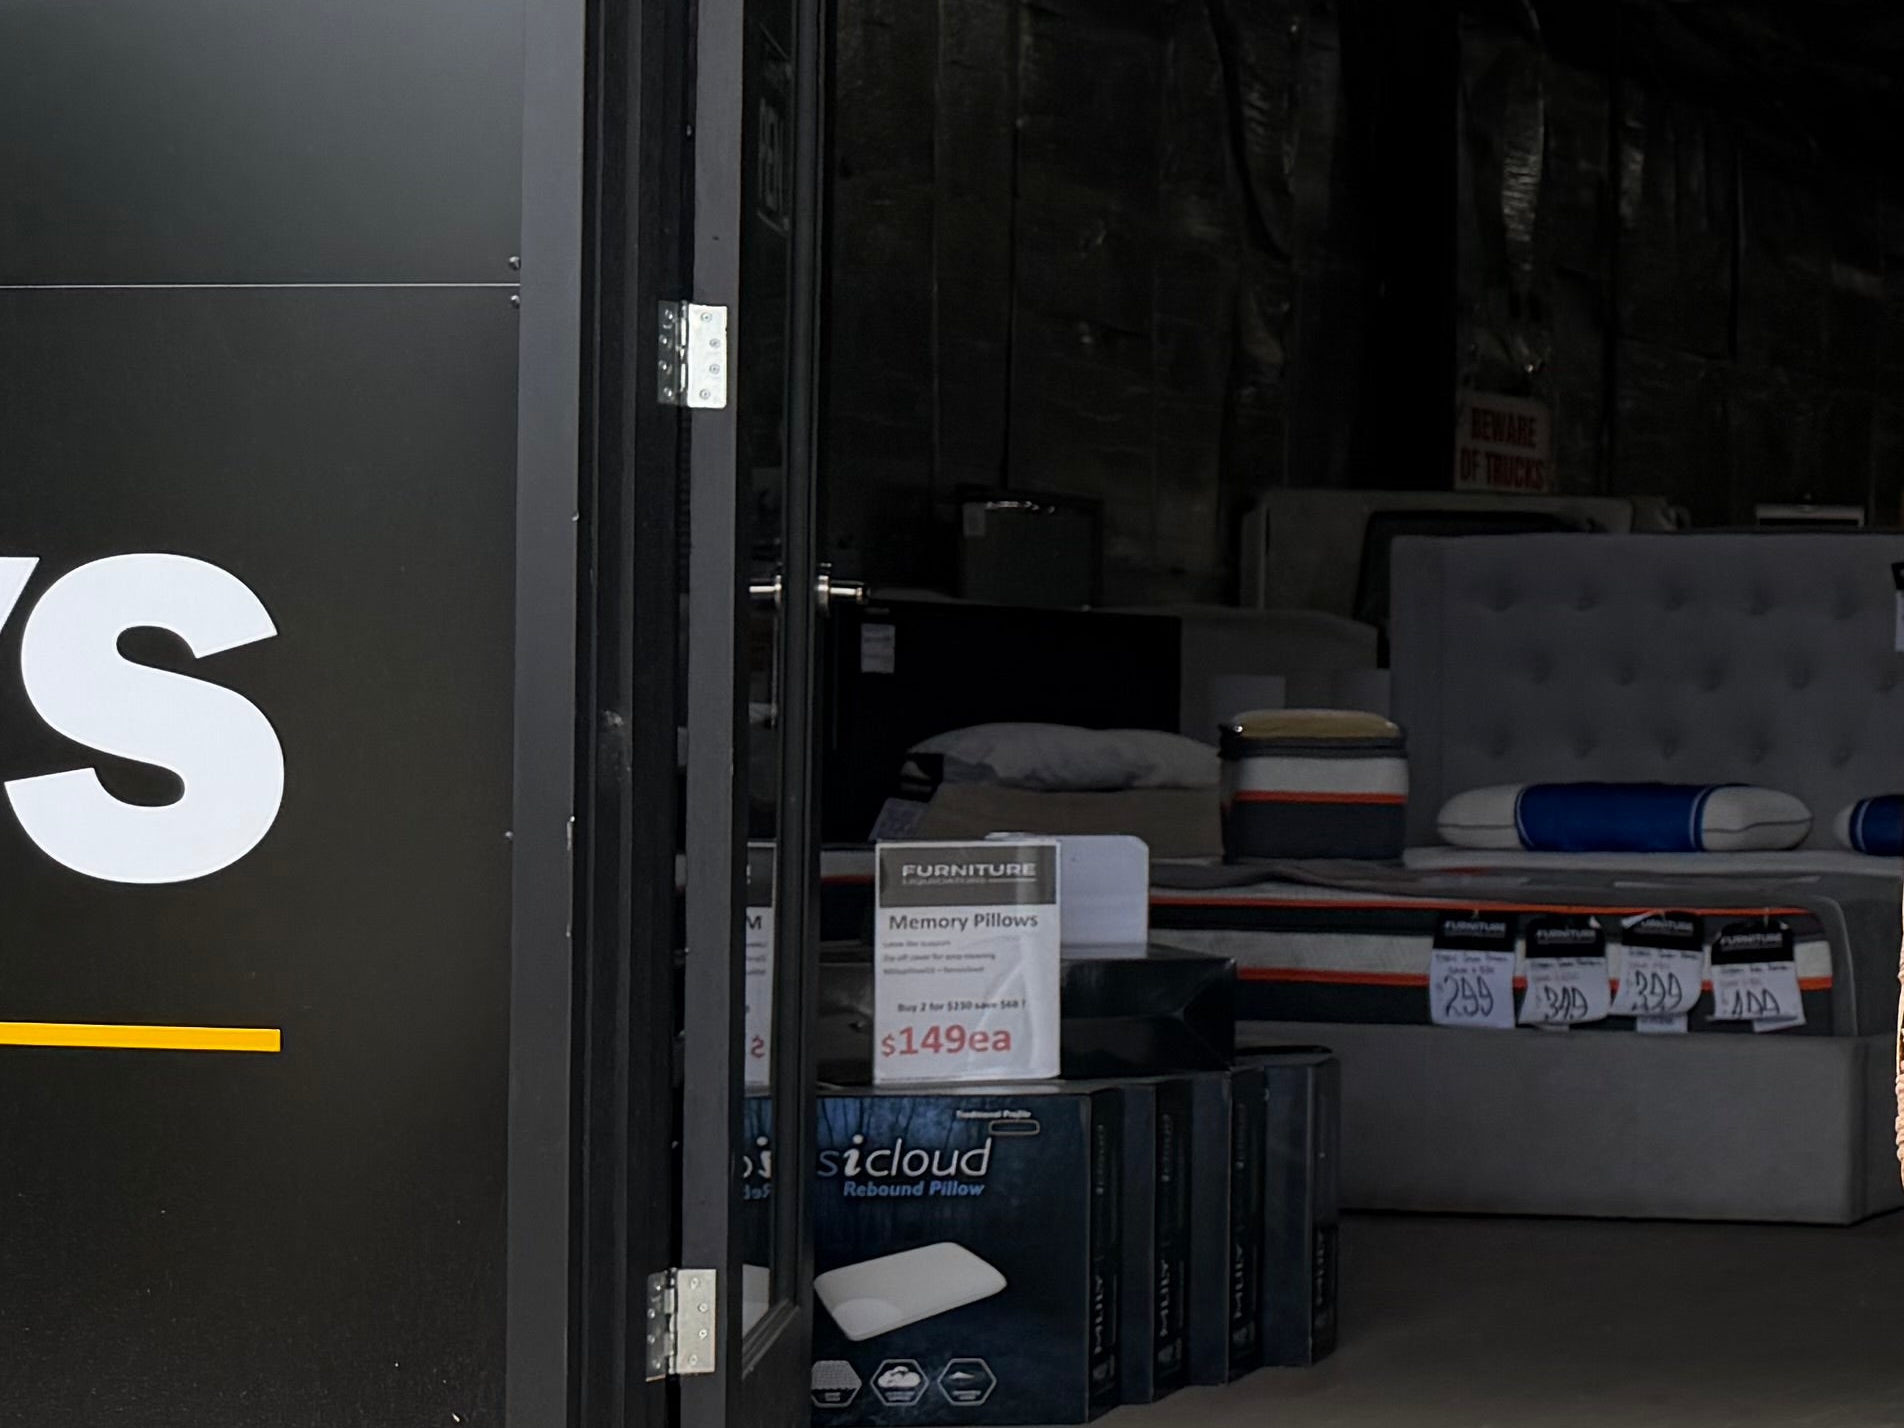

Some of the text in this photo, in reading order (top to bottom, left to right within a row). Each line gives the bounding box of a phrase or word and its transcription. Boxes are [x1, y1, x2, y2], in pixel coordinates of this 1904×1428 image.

[1471, 407, 1537, 449] BEWARE
[1460, 448, 1545, 489] OF TRUCKS
[901, 862, 1038, 878] FURNITURE
[888, 912, 1039, 933] Memory Pillows
[897, 1003, 918, 1013] Buy
[929, 1001, 944, 1011] for
[881, 1024, 1012, 1058] $149ea
[843, 1180, 986, 1197] Rebound Pillow
